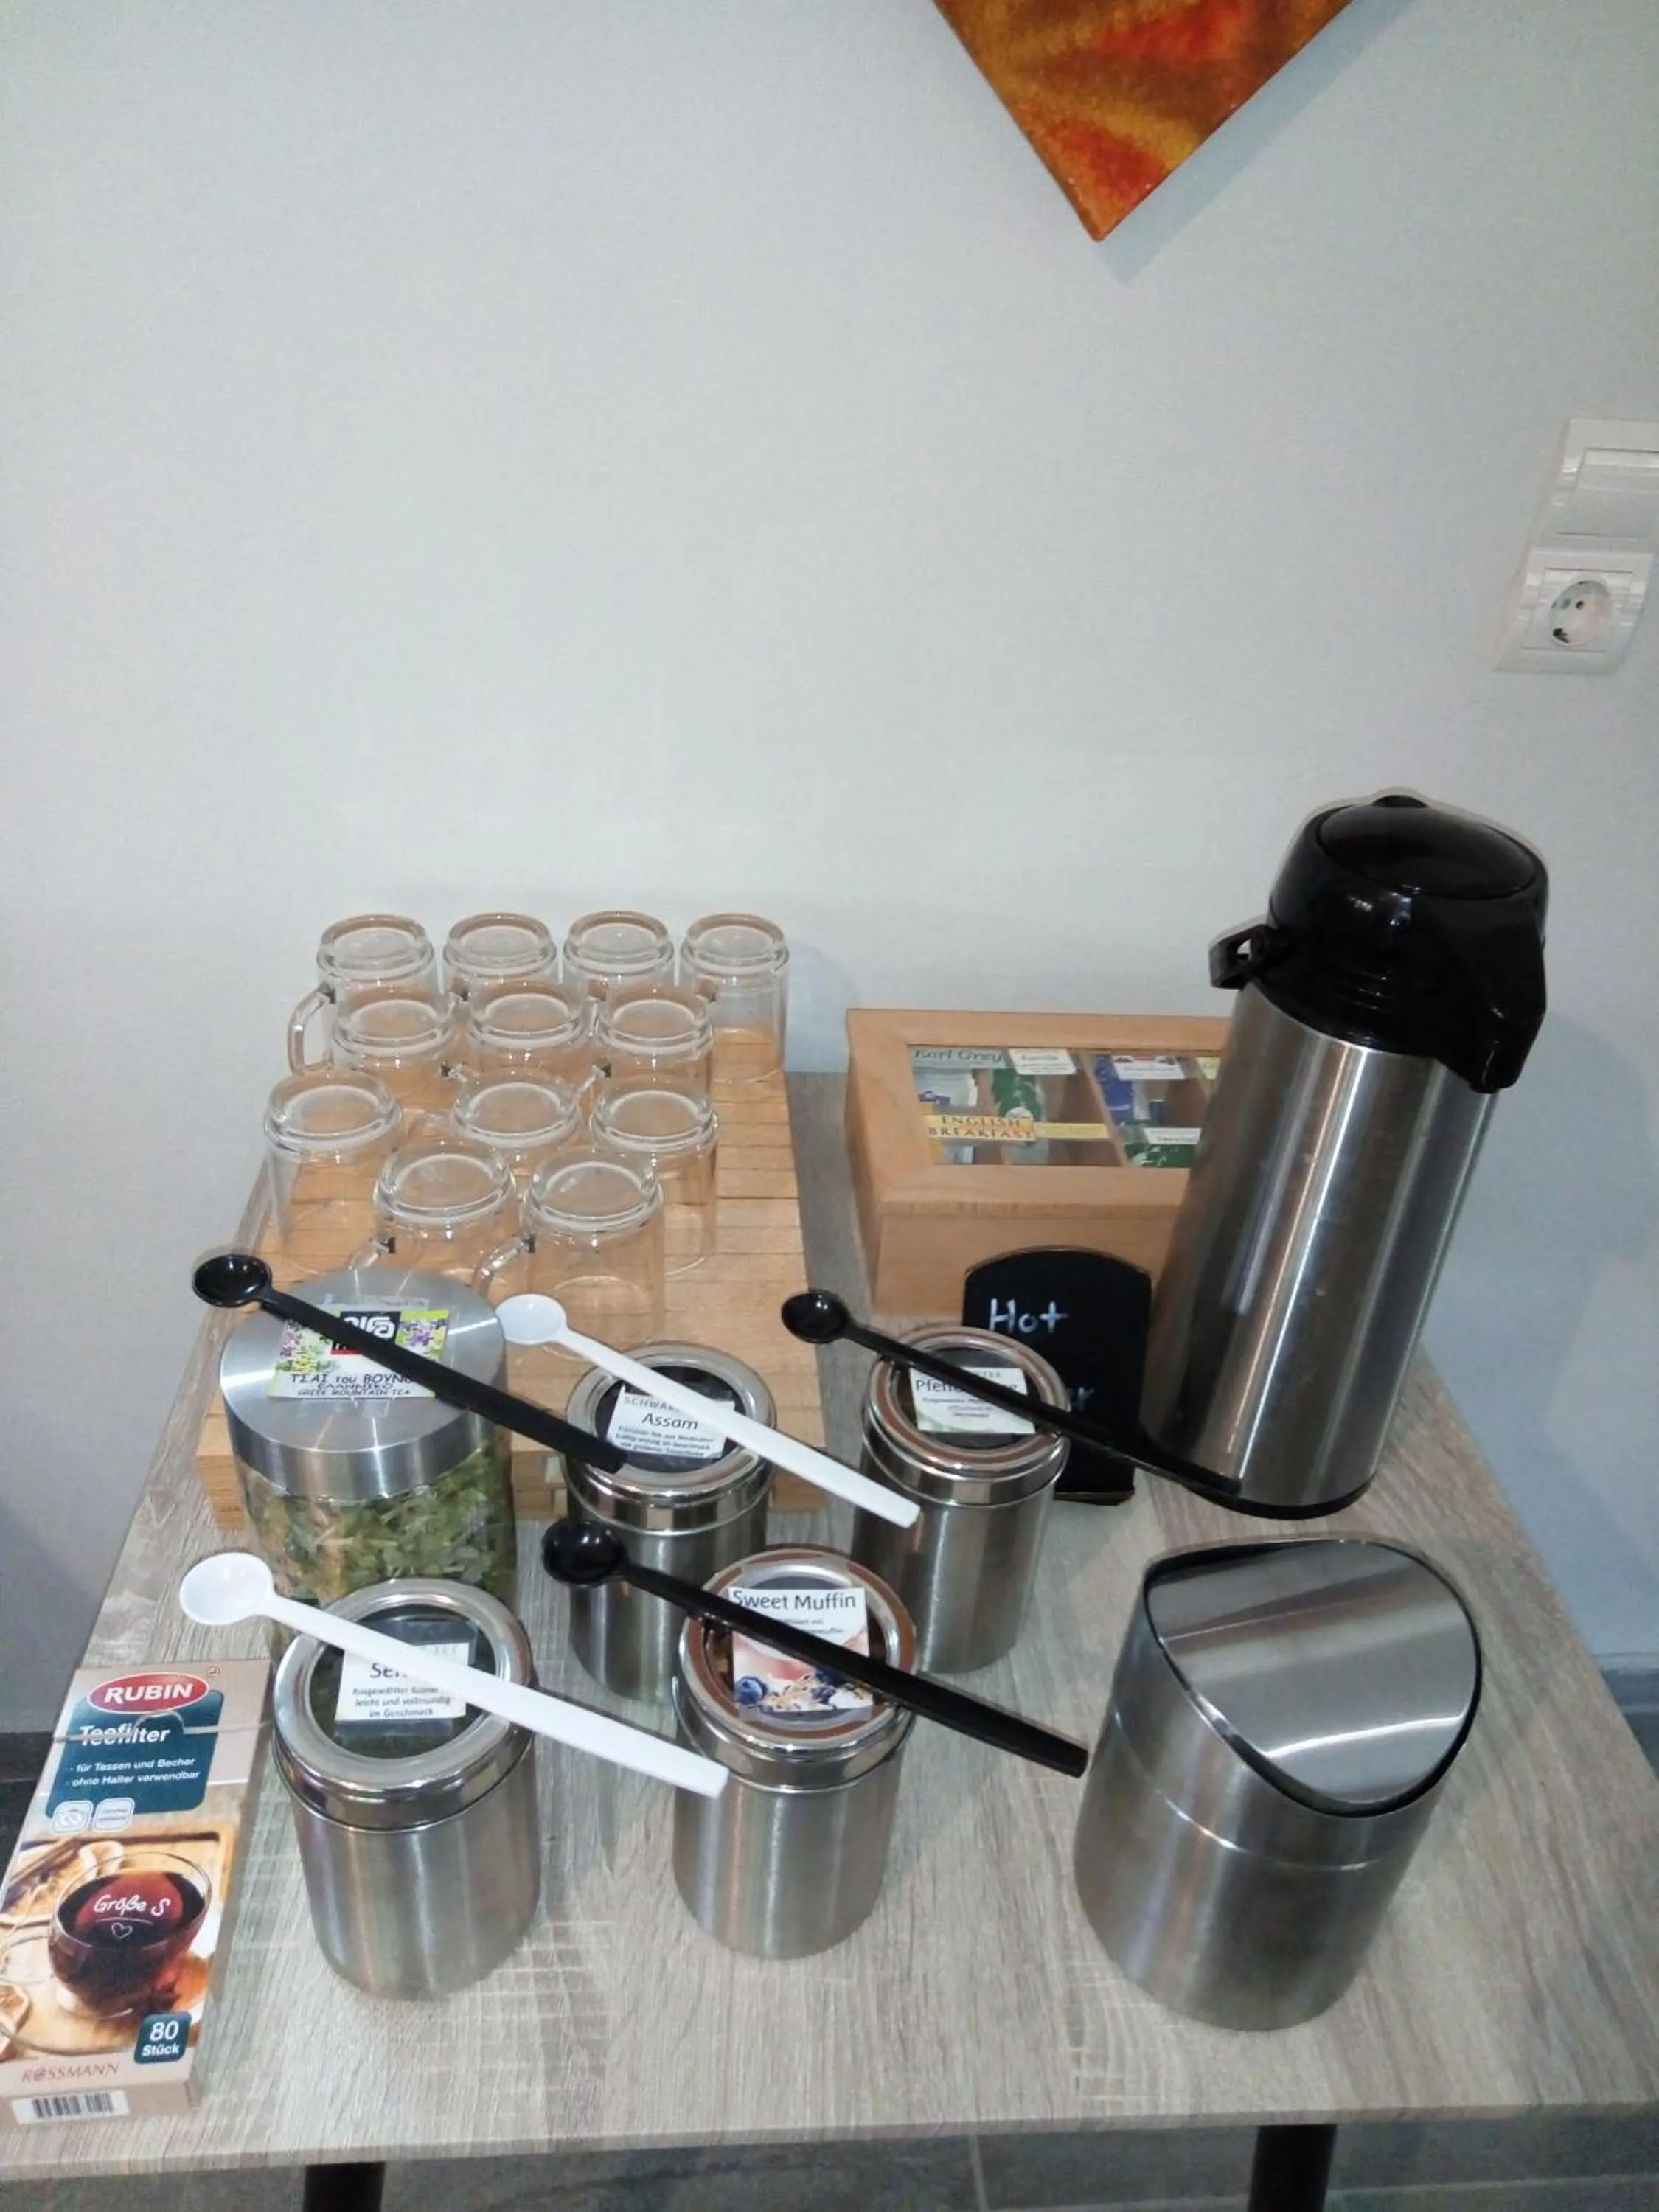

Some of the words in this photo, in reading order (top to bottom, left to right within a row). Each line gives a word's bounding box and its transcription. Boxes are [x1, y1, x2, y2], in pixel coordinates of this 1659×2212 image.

[928, 1127, 1034, 1139] BREAKFAST
[988, 1298, 1069, 1334] Hot
[641, 1412, 699, 1430] Assam
[732, 1590, 787, 1610] Sweet
[794, 1593, 856, 1611] Muffin
[104, 1683, 193, 1705] RUBIN
[80, 1722, 170, 1747] Teefilter
[76, 1763, 91, 1773] für
[94, 1761, 131, 1771] Tassen
[134, 1759, 155, 1769] und
[157, 1756, 195, 1767] Becher
[72, 1778, 100, 1787] ohne
[137, 1771, 201, 1783] verwendbar
[94, 1894, 147, 1916] Größe
[150, 1898, 171, 1916] S
[150, 2020, 179, 2042] 80
[142, 2043, 180, 2057] Stück
[21, 2062, 120, 2084] ROSSMANN
